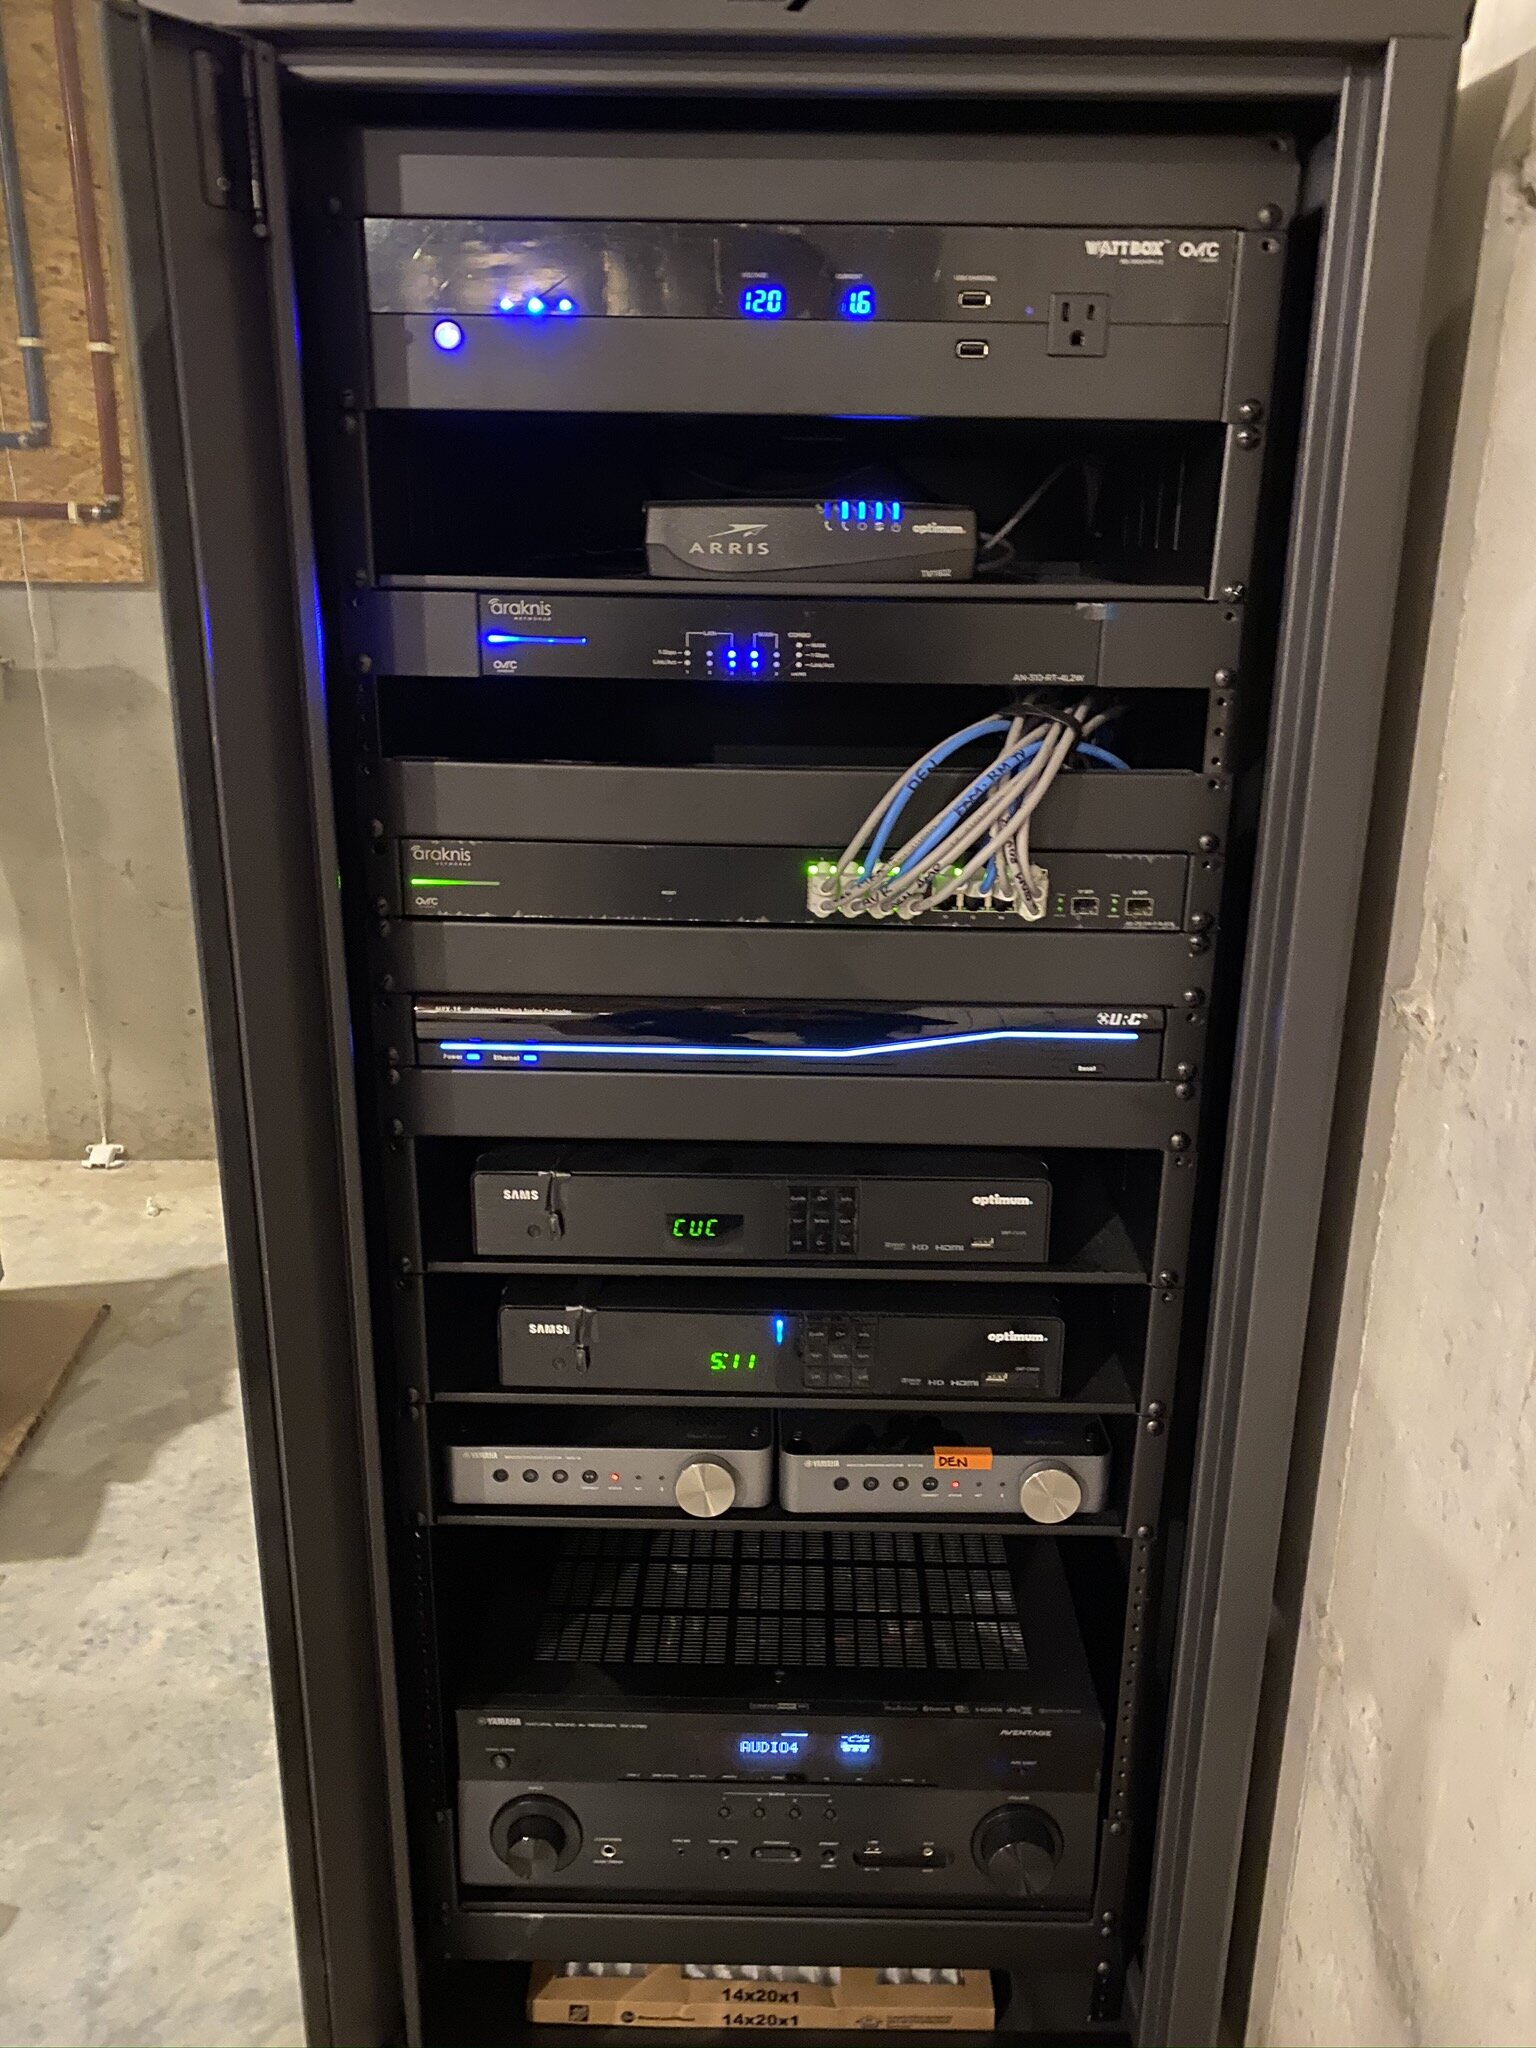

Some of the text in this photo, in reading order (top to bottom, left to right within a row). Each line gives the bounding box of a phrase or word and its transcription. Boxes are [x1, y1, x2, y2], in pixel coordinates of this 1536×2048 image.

[744, 289, 783, 313] 120
[688, 542, 770, 556] ARRIS
[488, 598, 553, 616] araknis
[906, 759, 938, 792] DEN
[410, 846, 472, 862] araknis
[672, 1218, 719, 1238] CUC
[938, 1455, 968, 1468] DEN
[486, 1717, 522, 1727] YAMAHA
[739, 1740, 799, 1754] AUDIO4
[721, 1988, 801, 2004] 14x20x1
[722, 2013, 800, 2028] 14x20x1
